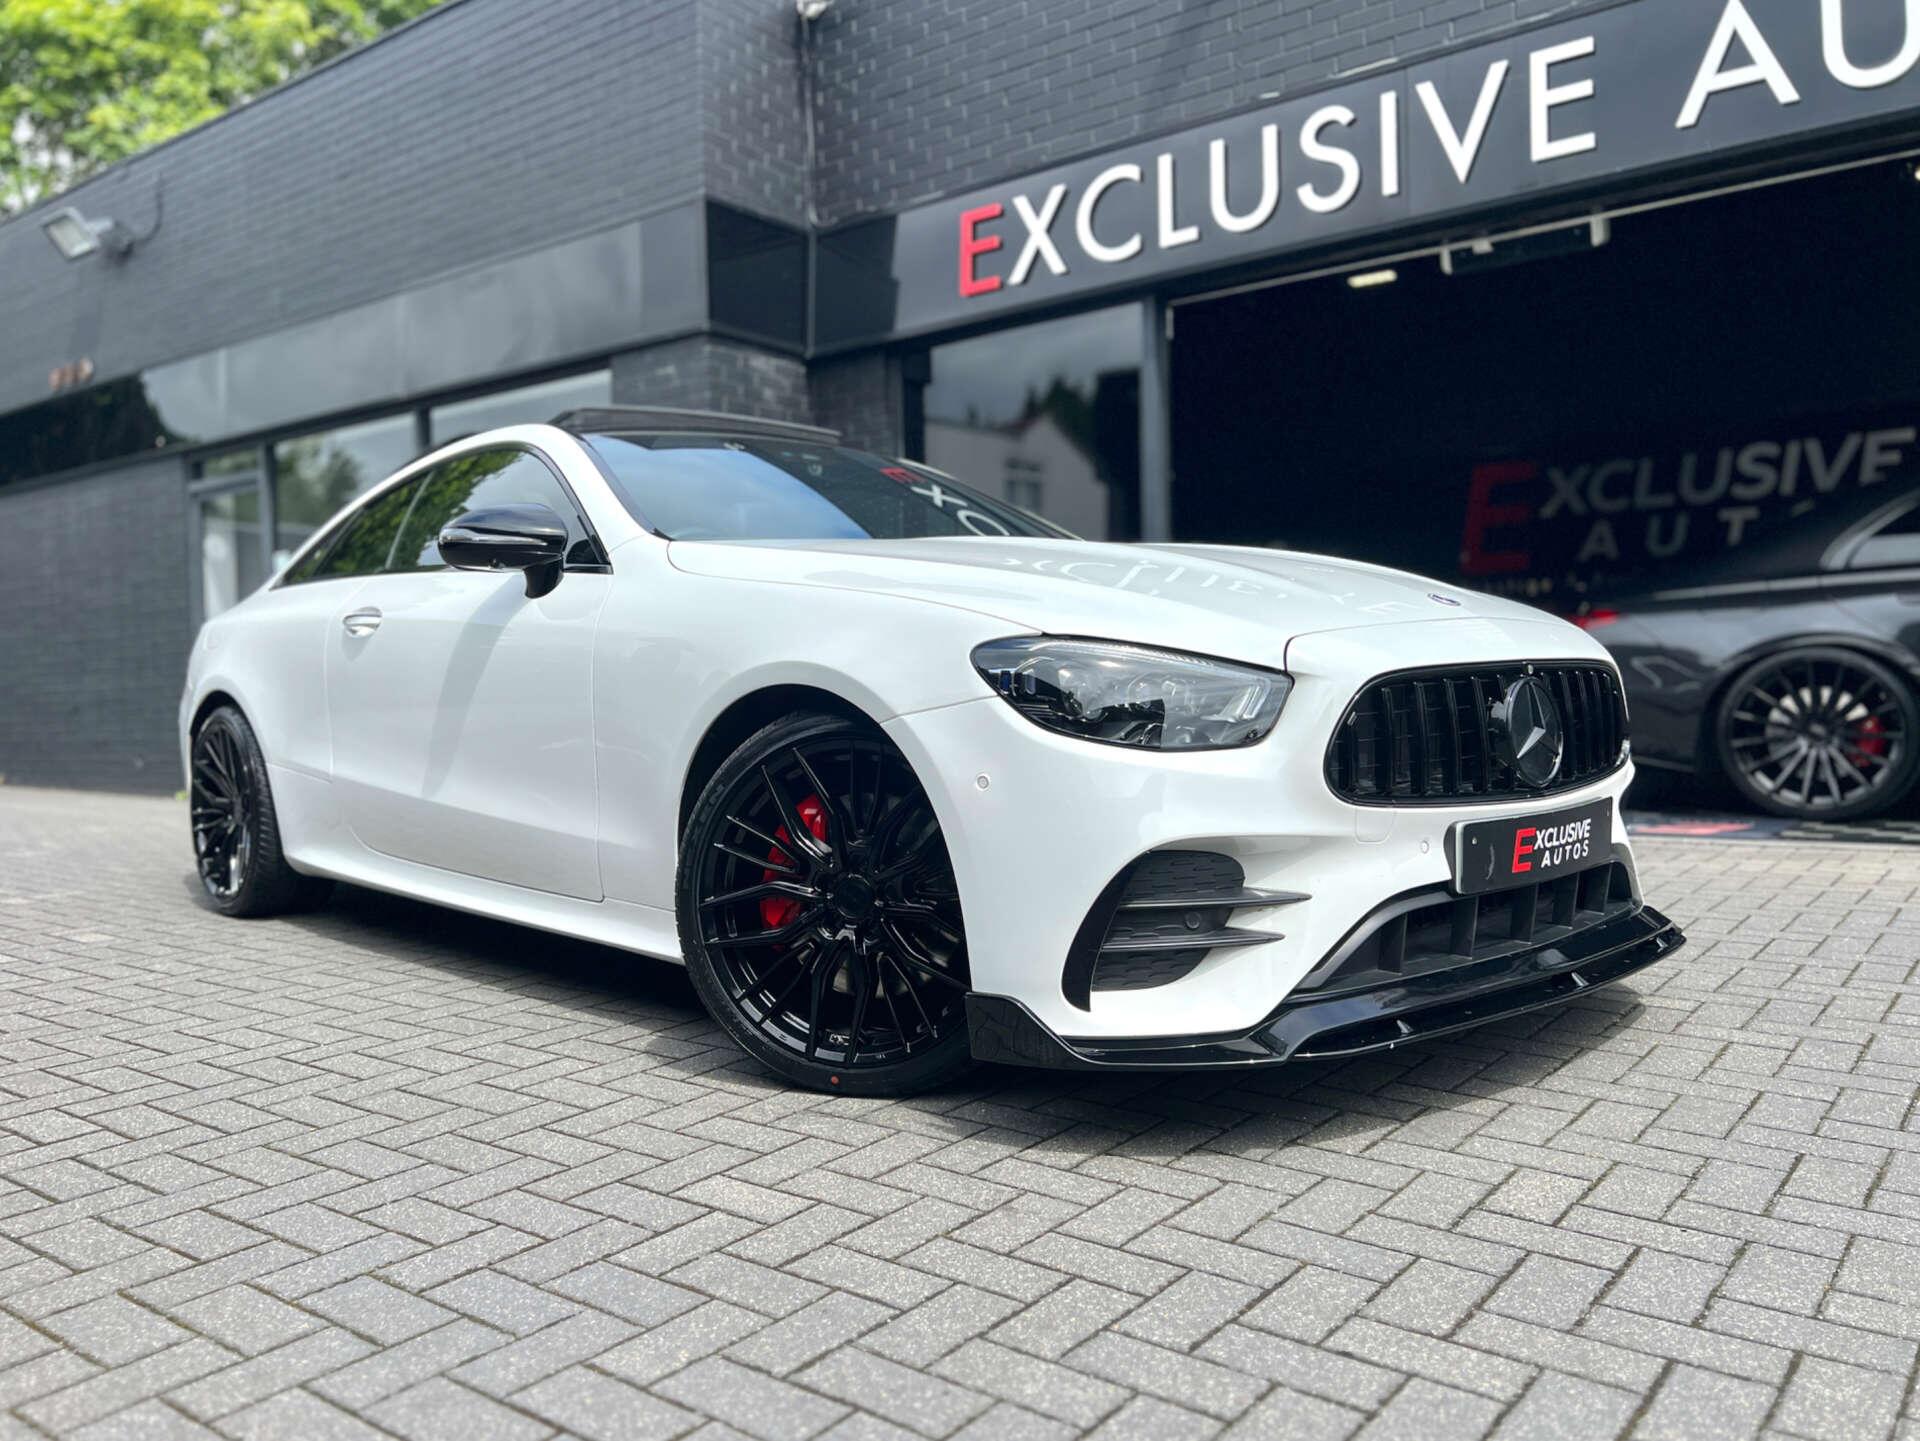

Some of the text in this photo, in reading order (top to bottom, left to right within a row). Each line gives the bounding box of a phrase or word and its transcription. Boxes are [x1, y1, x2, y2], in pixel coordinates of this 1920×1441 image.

[959, 36, 1598, 297] EXCLUSIVE
[1512, 819, 1591, 873] EXCLUSIVE
[1542, 840, 1589, 867] AUTOS
